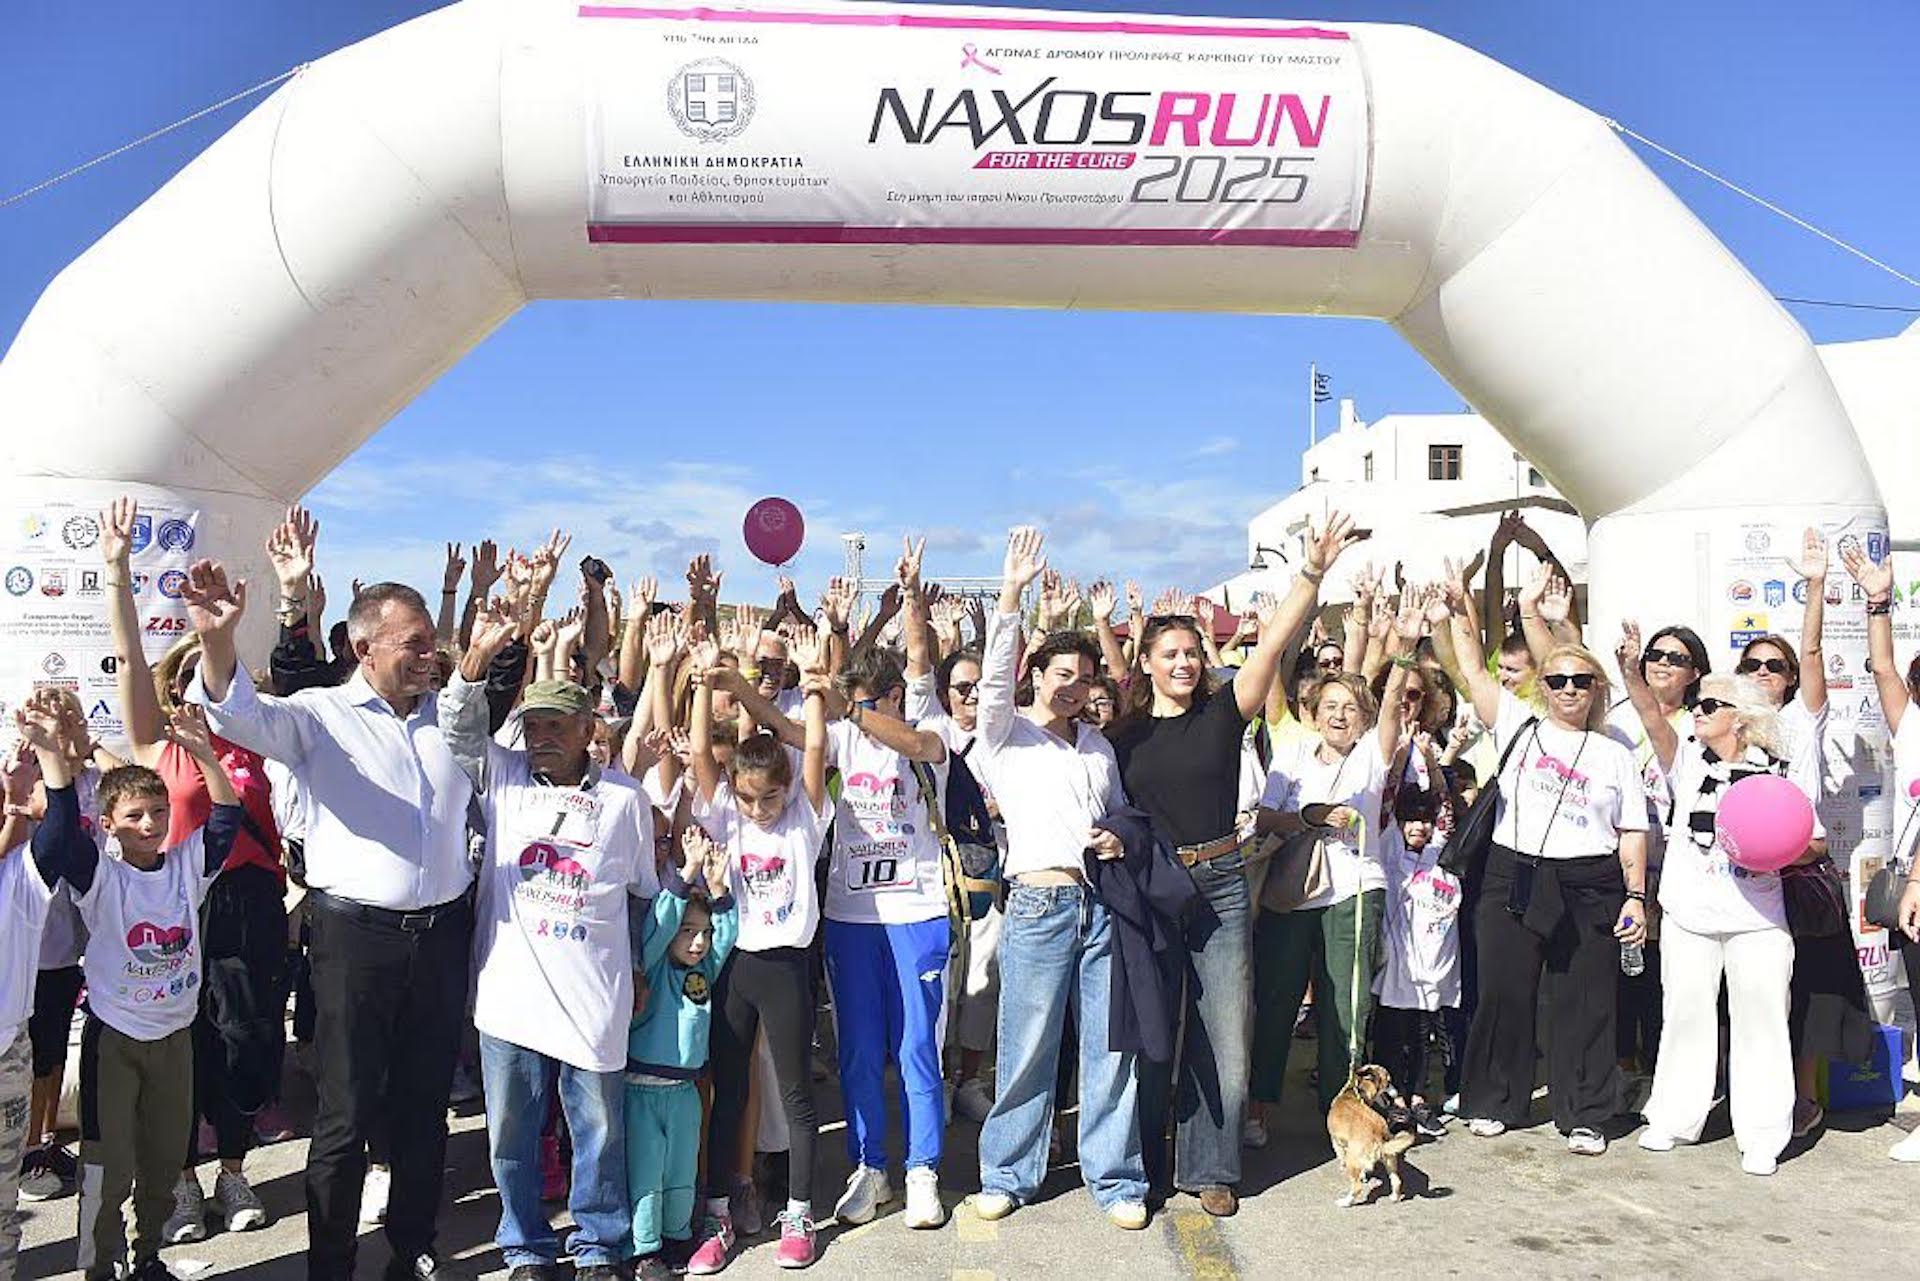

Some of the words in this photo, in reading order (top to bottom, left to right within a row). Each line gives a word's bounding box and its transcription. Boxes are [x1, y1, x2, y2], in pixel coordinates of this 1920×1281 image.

[1259, 54, 1284, 65] ΤΟΥ
[624, 155, 699, 168] ΕΛΛΗΝΙΚΗ
[705, 156, 804, 168] ΔΗΜΟΚΡΑΤΙΑ
[989, 154, 1029, 168] FOR
[1034, 154, 1073, 168] THE
[1077, 154, 1128, 168] CURE
[1130, 155, 1315, 203] 2025
[668, 193, 687, 204] και
[146, 617, 186, 630] ZAS
[863, 859, 897, 884] 10
